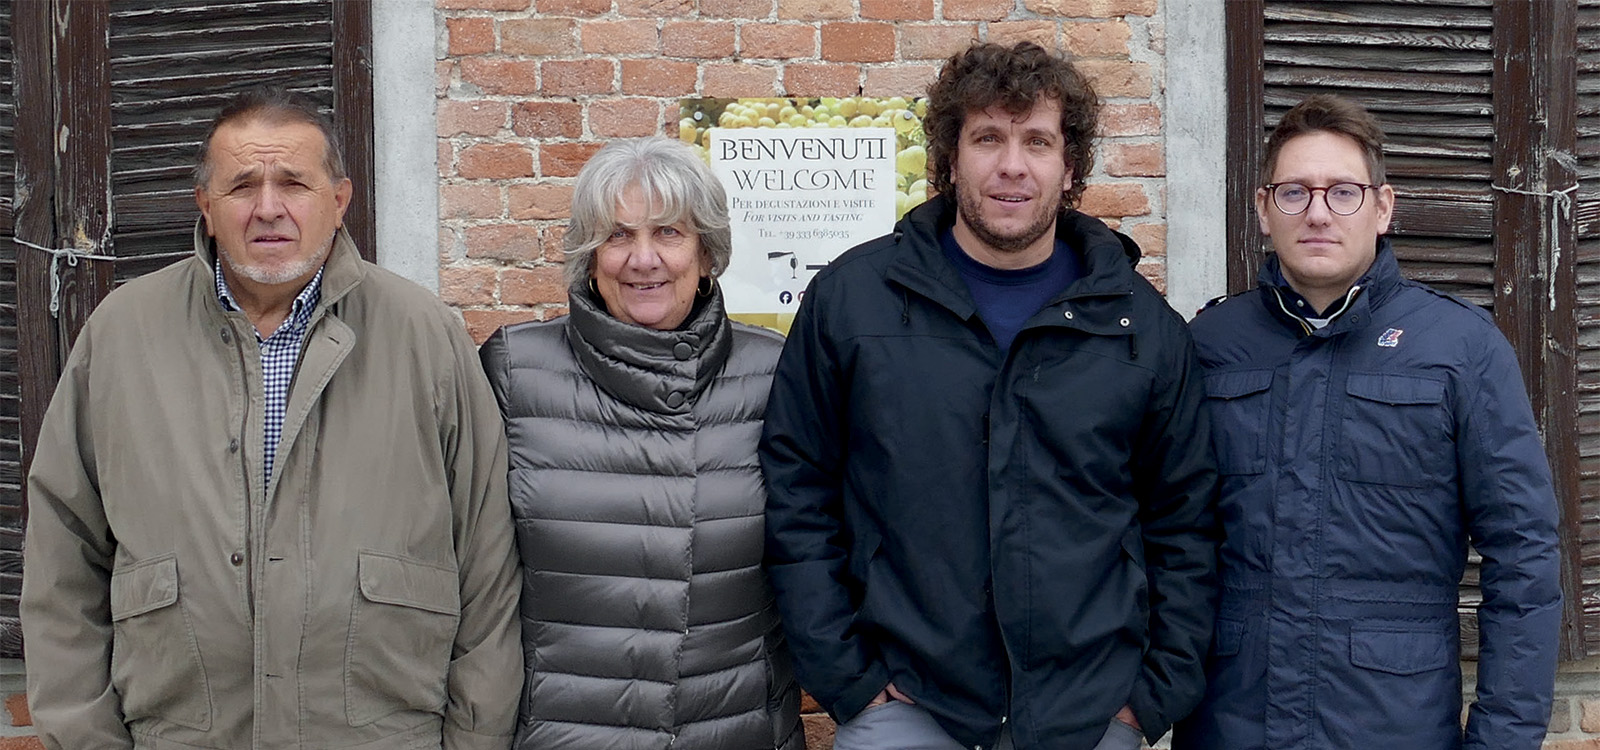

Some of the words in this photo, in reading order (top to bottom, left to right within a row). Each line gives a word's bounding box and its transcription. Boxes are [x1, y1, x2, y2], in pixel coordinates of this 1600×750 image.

[719, 137, 888, 161] BENVENUTI
[732, 168, 877, 191] WELCOME
[732, 197, 753, 209] PER
[755, 199, 831, 209] DEGUSTAZIONI
[833, 200, 841, 208] E
[842, 199, 876, 209] VISITE
[743, 210, 765, 222] FOR
[767, 213, 797, 222] VISITS
[800, 213, 821, 222] AND
[823, 213, 864, 222] TASTING
